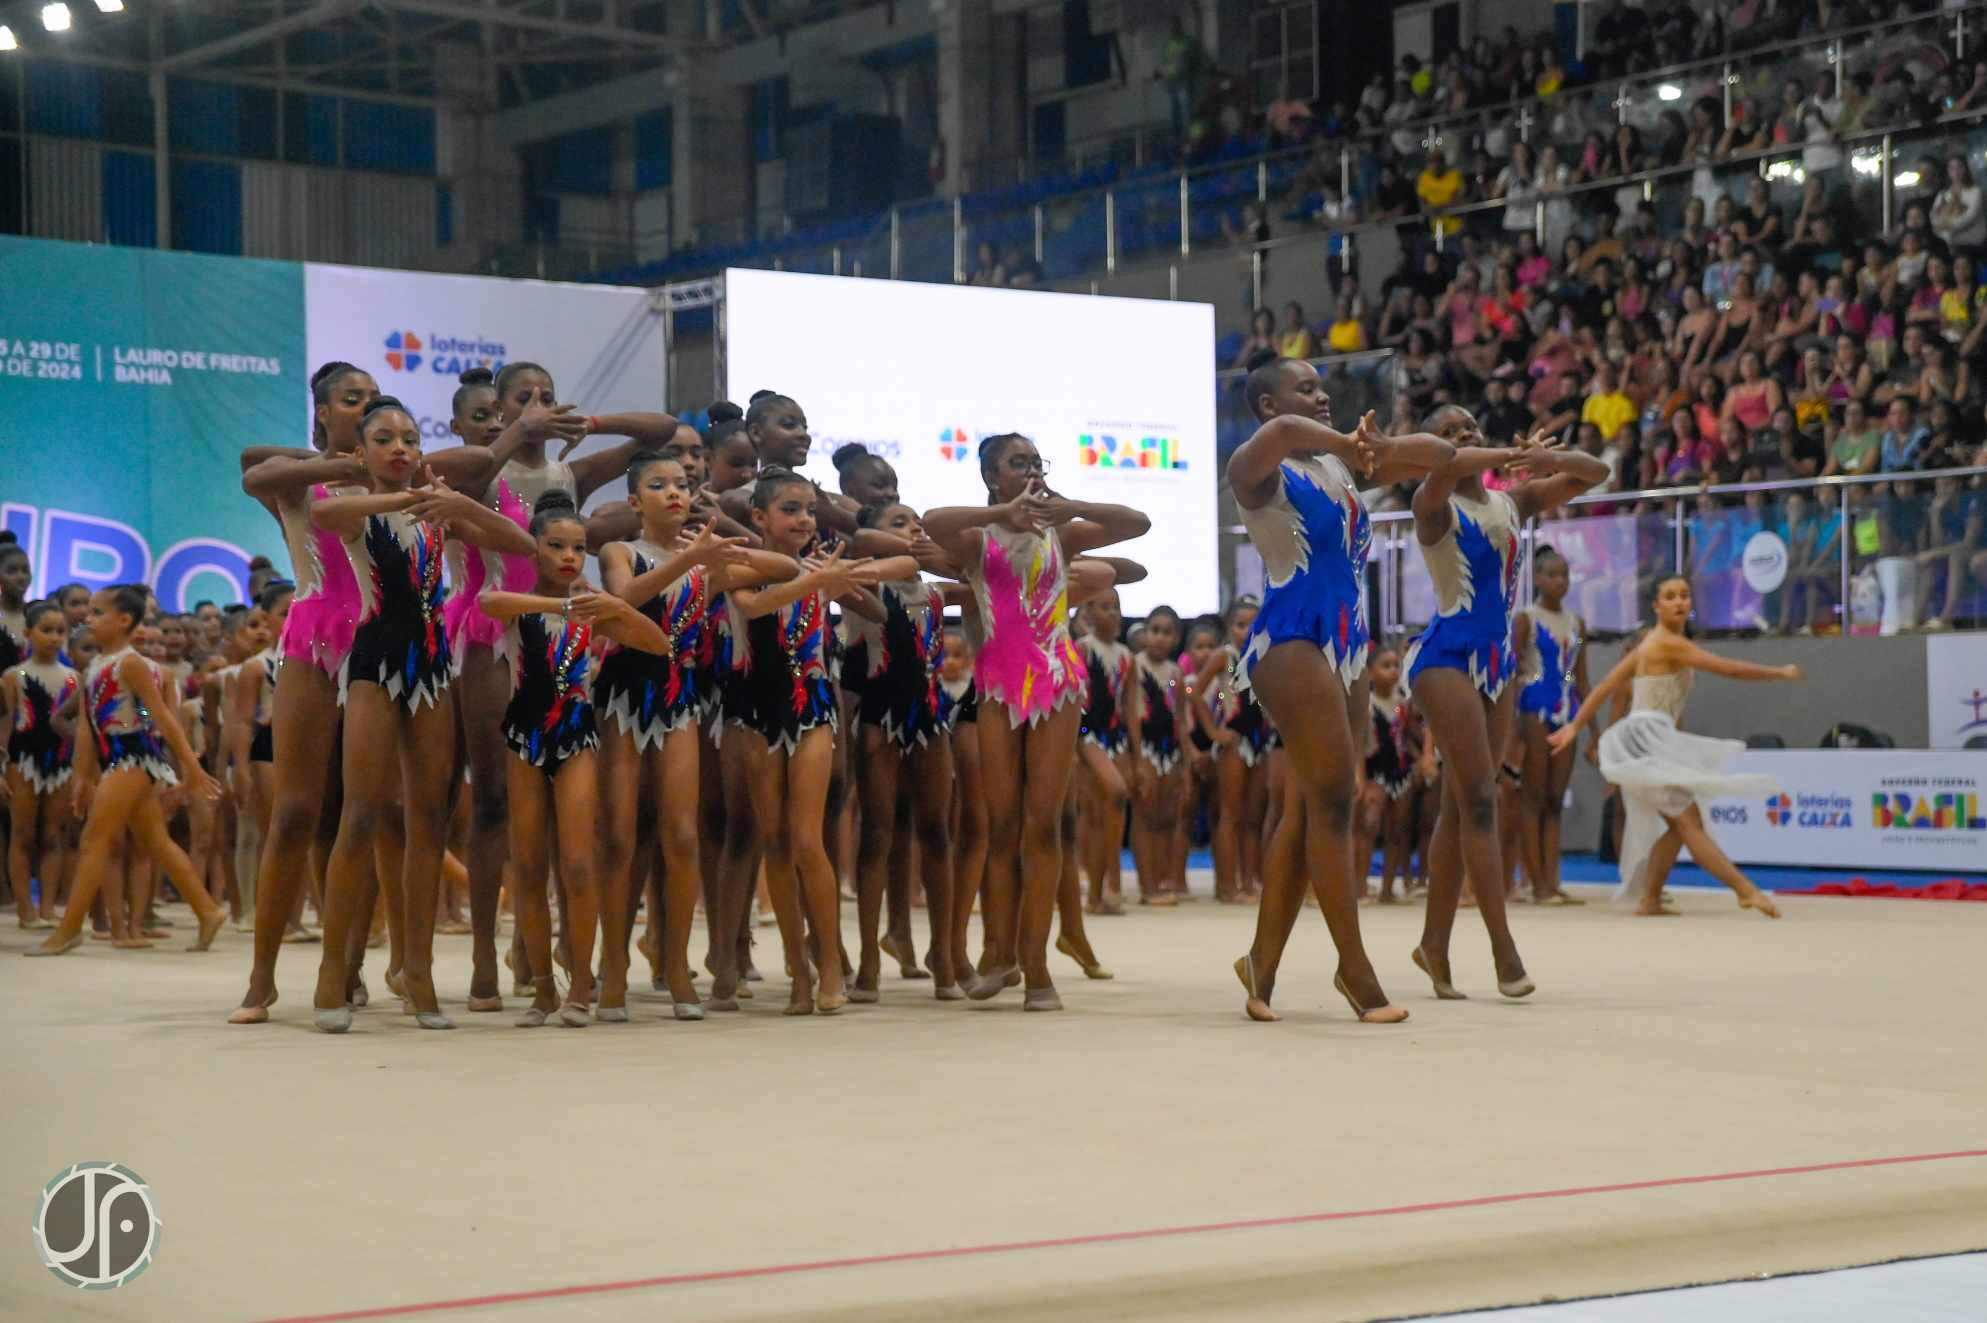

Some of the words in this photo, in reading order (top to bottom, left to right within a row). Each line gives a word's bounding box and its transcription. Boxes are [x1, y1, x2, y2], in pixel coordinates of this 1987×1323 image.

[12, 340, 25, 356] A
[30, 341, 51, 359] 29
[56, 342, 80, 361] DE
[431, 333, 506, 356] loterias
[8, 357, 32, 377] DE
[38, 360, 81, 380] 2024
[114, 346, 177, 368] LAURO
[182, 352, 207, 370] DE
[210, 352, 280, 376] FREITAS
[115, 365, 172, 385] BAHIA
[1079, 434, 1188, 469] BRASIL
[1797, 791, 1852, 808] loterias
[1872, 793, 1986, 829] BRASIL
[1798, 811, 1853, 828] CAIXA
